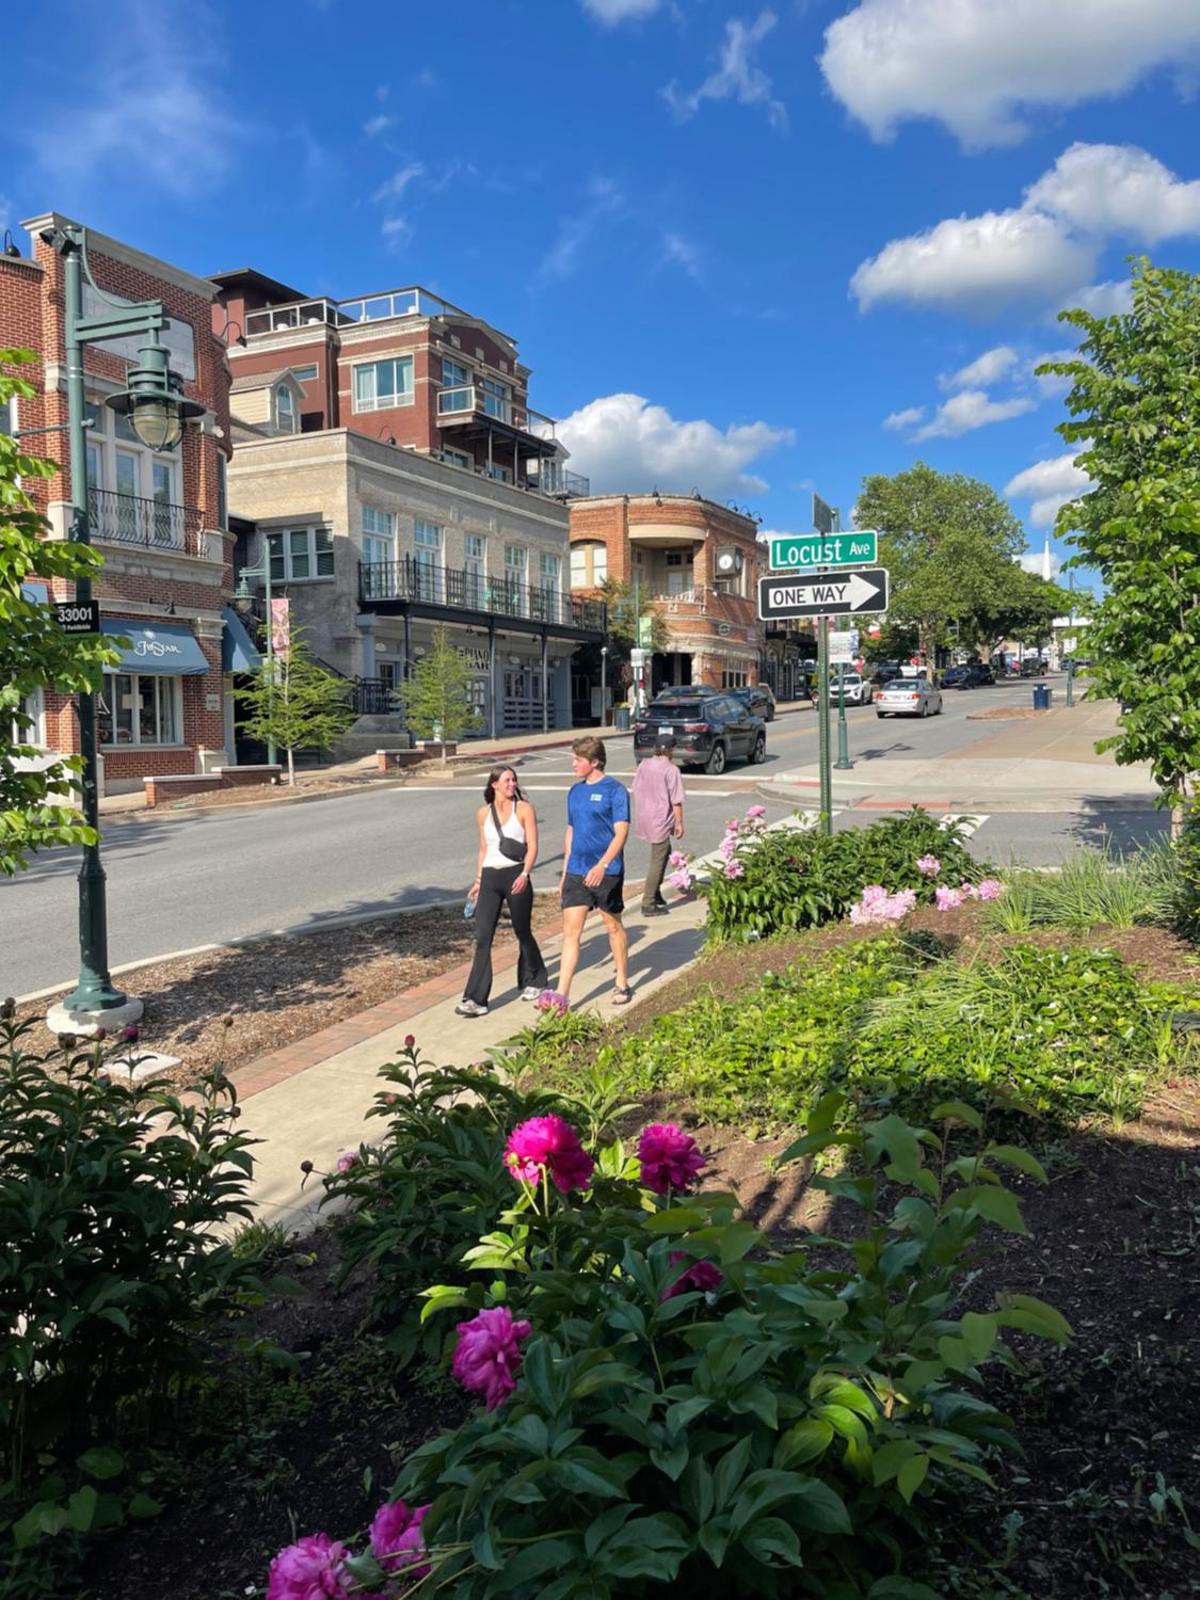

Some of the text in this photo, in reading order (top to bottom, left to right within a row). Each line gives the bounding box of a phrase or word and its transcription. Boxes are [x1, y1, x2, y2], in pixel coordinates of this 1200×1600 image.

[775, 539, 871, 565] Locust Ave
[773, 585, 846, 605] ONE WAY
[58, 607, 93, 622] 33001
